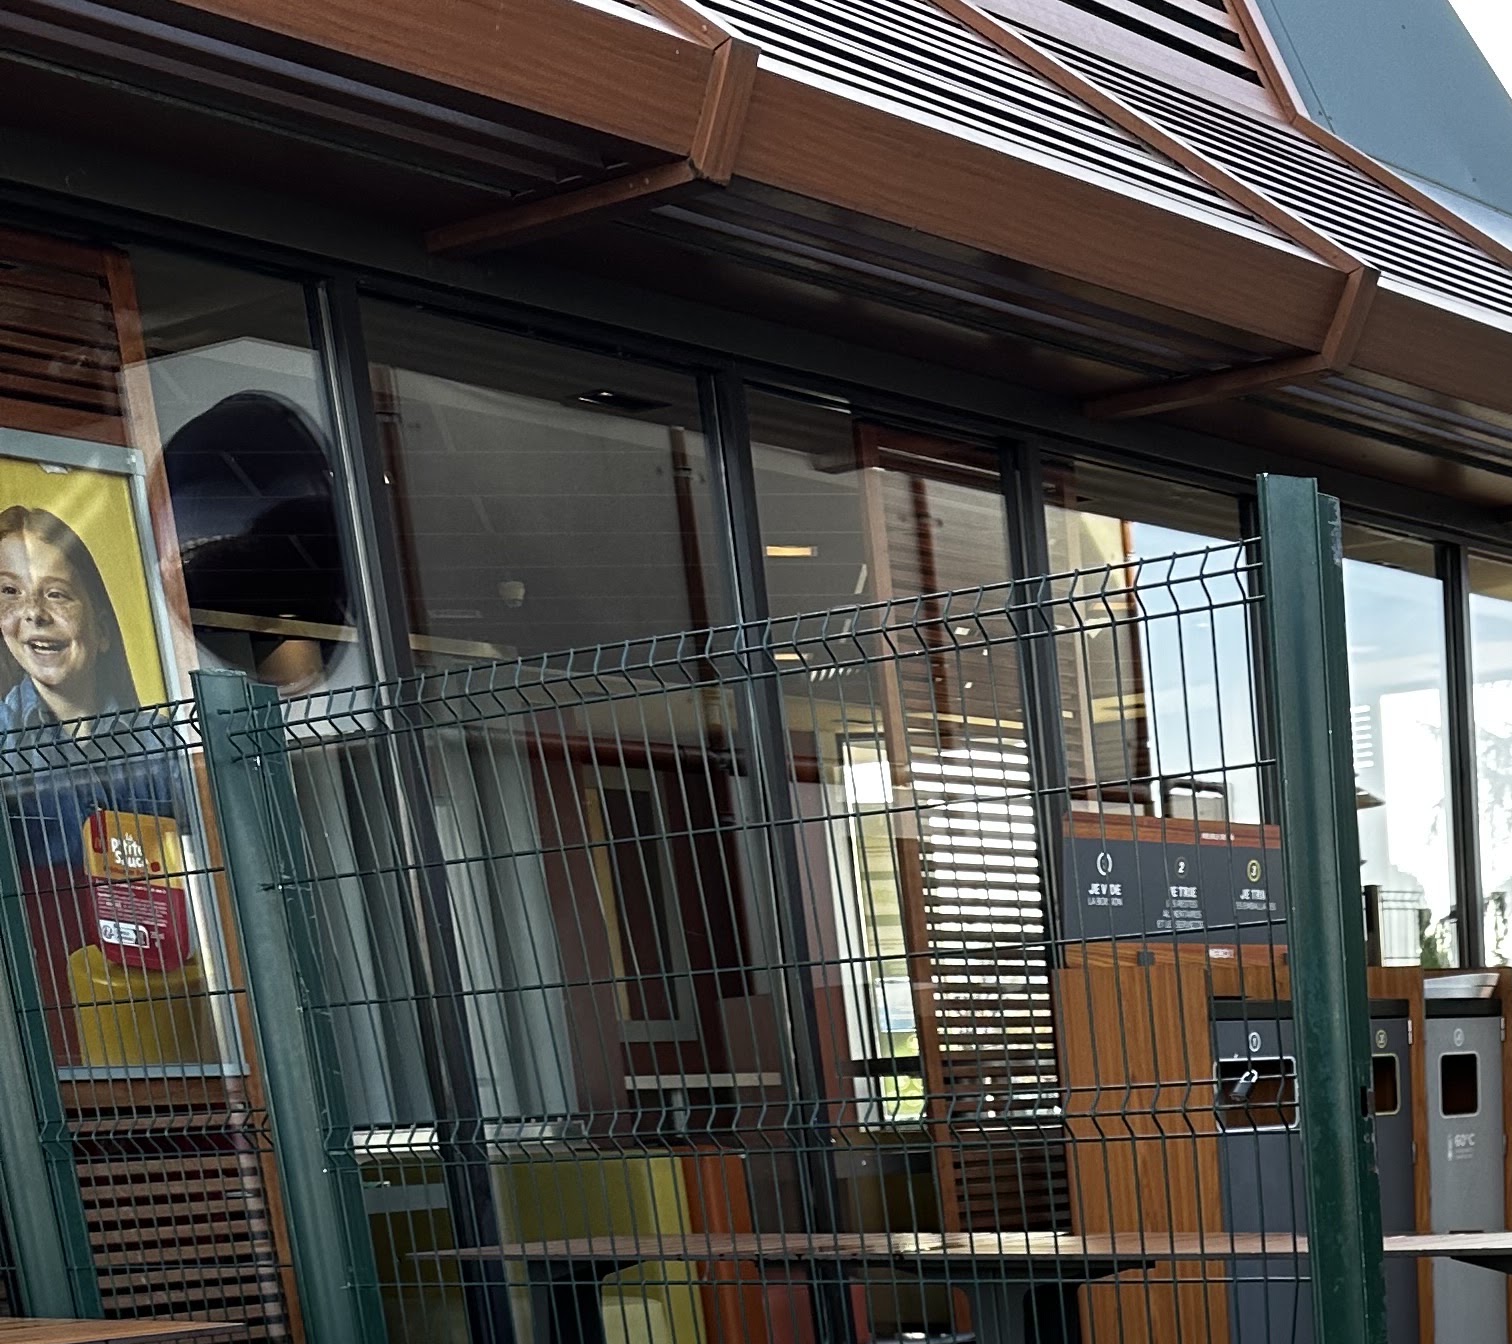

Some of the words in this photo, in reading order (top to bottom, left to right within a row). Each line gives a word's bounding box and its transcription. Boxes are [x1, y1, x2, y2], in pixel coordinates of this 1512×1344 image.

[1178, 862, 1186, 874] 2
[1088, 884, 1100, 895] JE
[1101, 884, 1122, 896] VDE
[1240, 889, 1250, 900] JE
[1251, 890, 1268, 900] TRI
